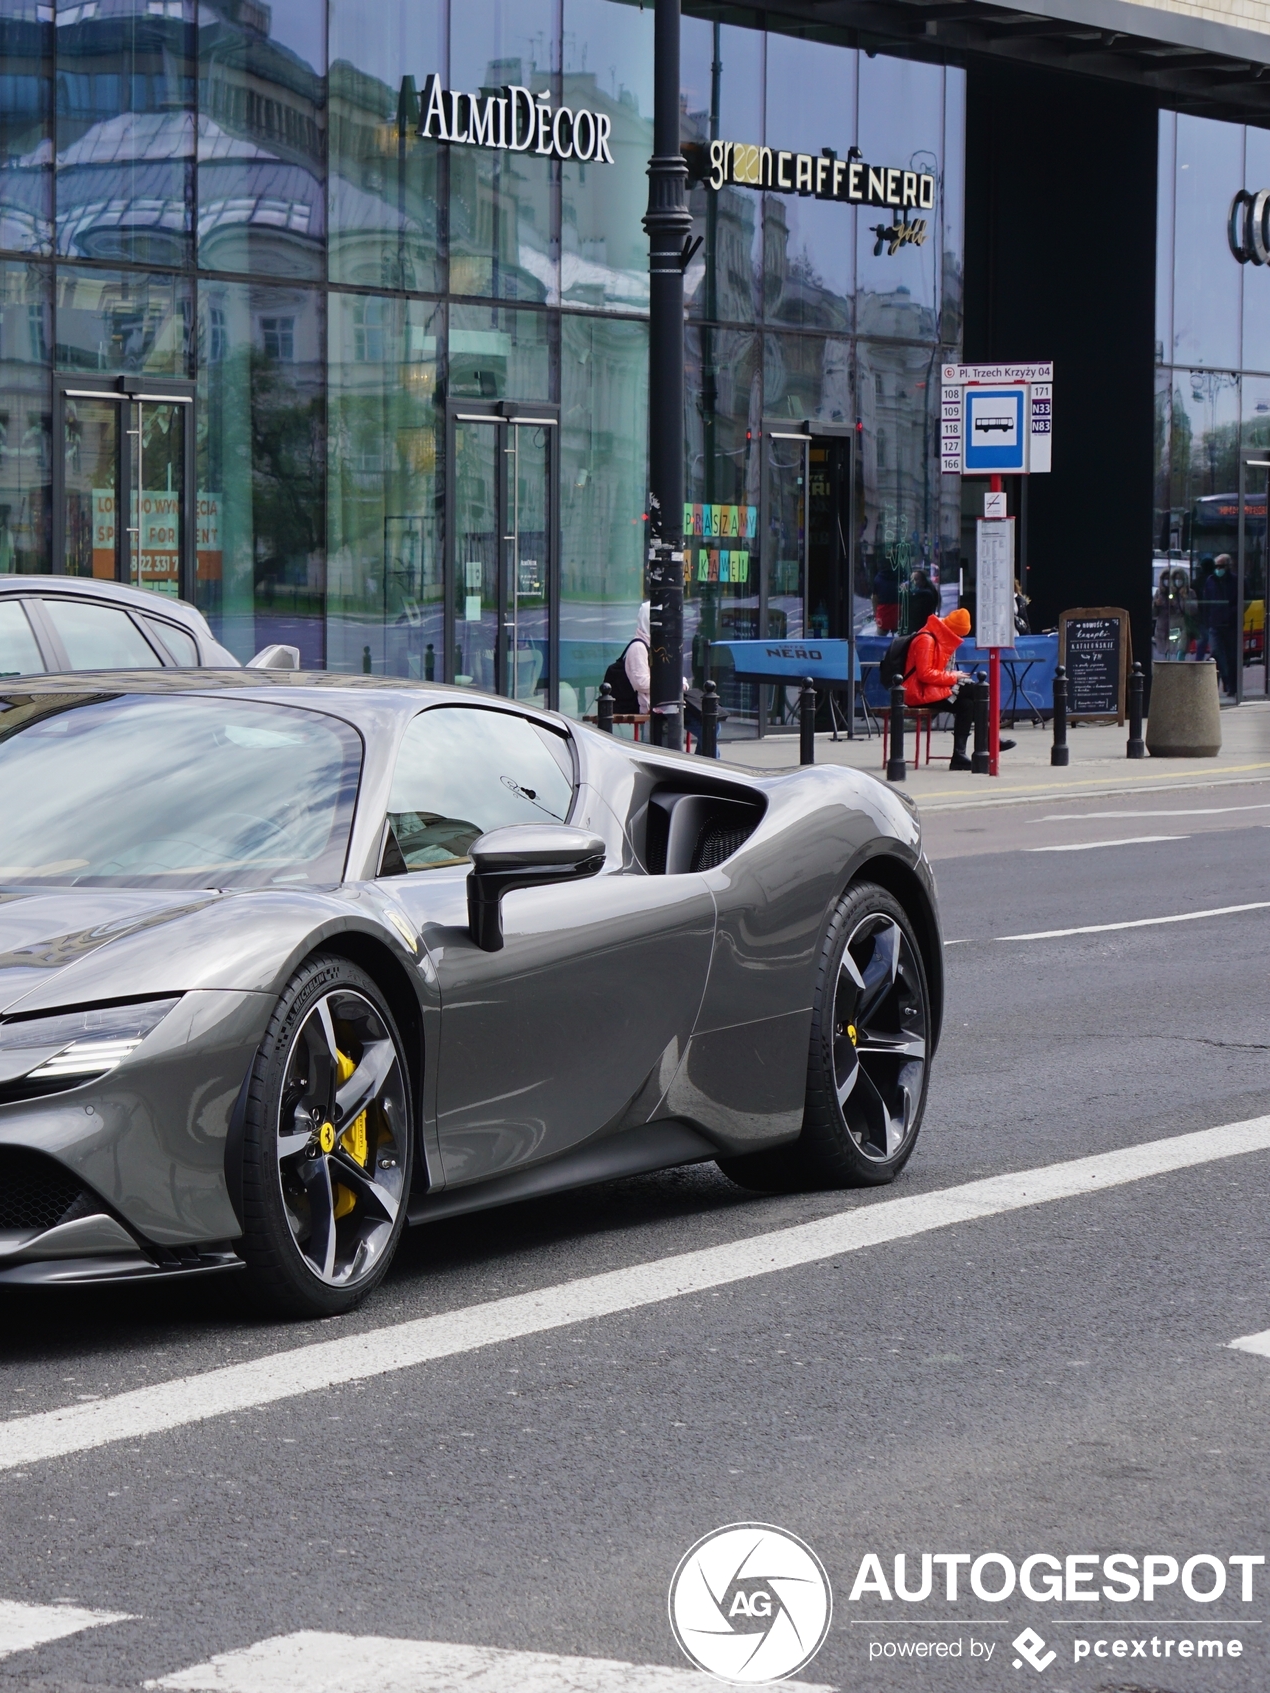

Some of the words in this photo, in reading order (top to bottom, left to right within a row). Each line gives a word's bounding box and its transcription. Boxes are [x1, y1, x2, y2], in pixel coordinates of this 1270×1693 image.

[422, 73, 615, 164] ALMIDÉCOR
[959, 369, 970, 378] Pl.
[973, 368, 1002, 378] Trzech
[1004, 366, 1036, 379] Krzyży
[1038, 367, 1050, 376] 04
[944, 390, 959, 398] 108
[1034, 387, 1049, 396] 171
[944, 407, 959, 416] 109
[1032, 404, 1050, 413] N33
[945, 425, 958, 433] 118
[1032, 421, 1050, 431] N83
[944, 442, 959, 451] 127
[944, 460, 959, 468] 166
[150, 527, 174, 543] FOR
[765, 648, 823, 660] NERO
[293, 970, 328, 1012] MICHELIN
